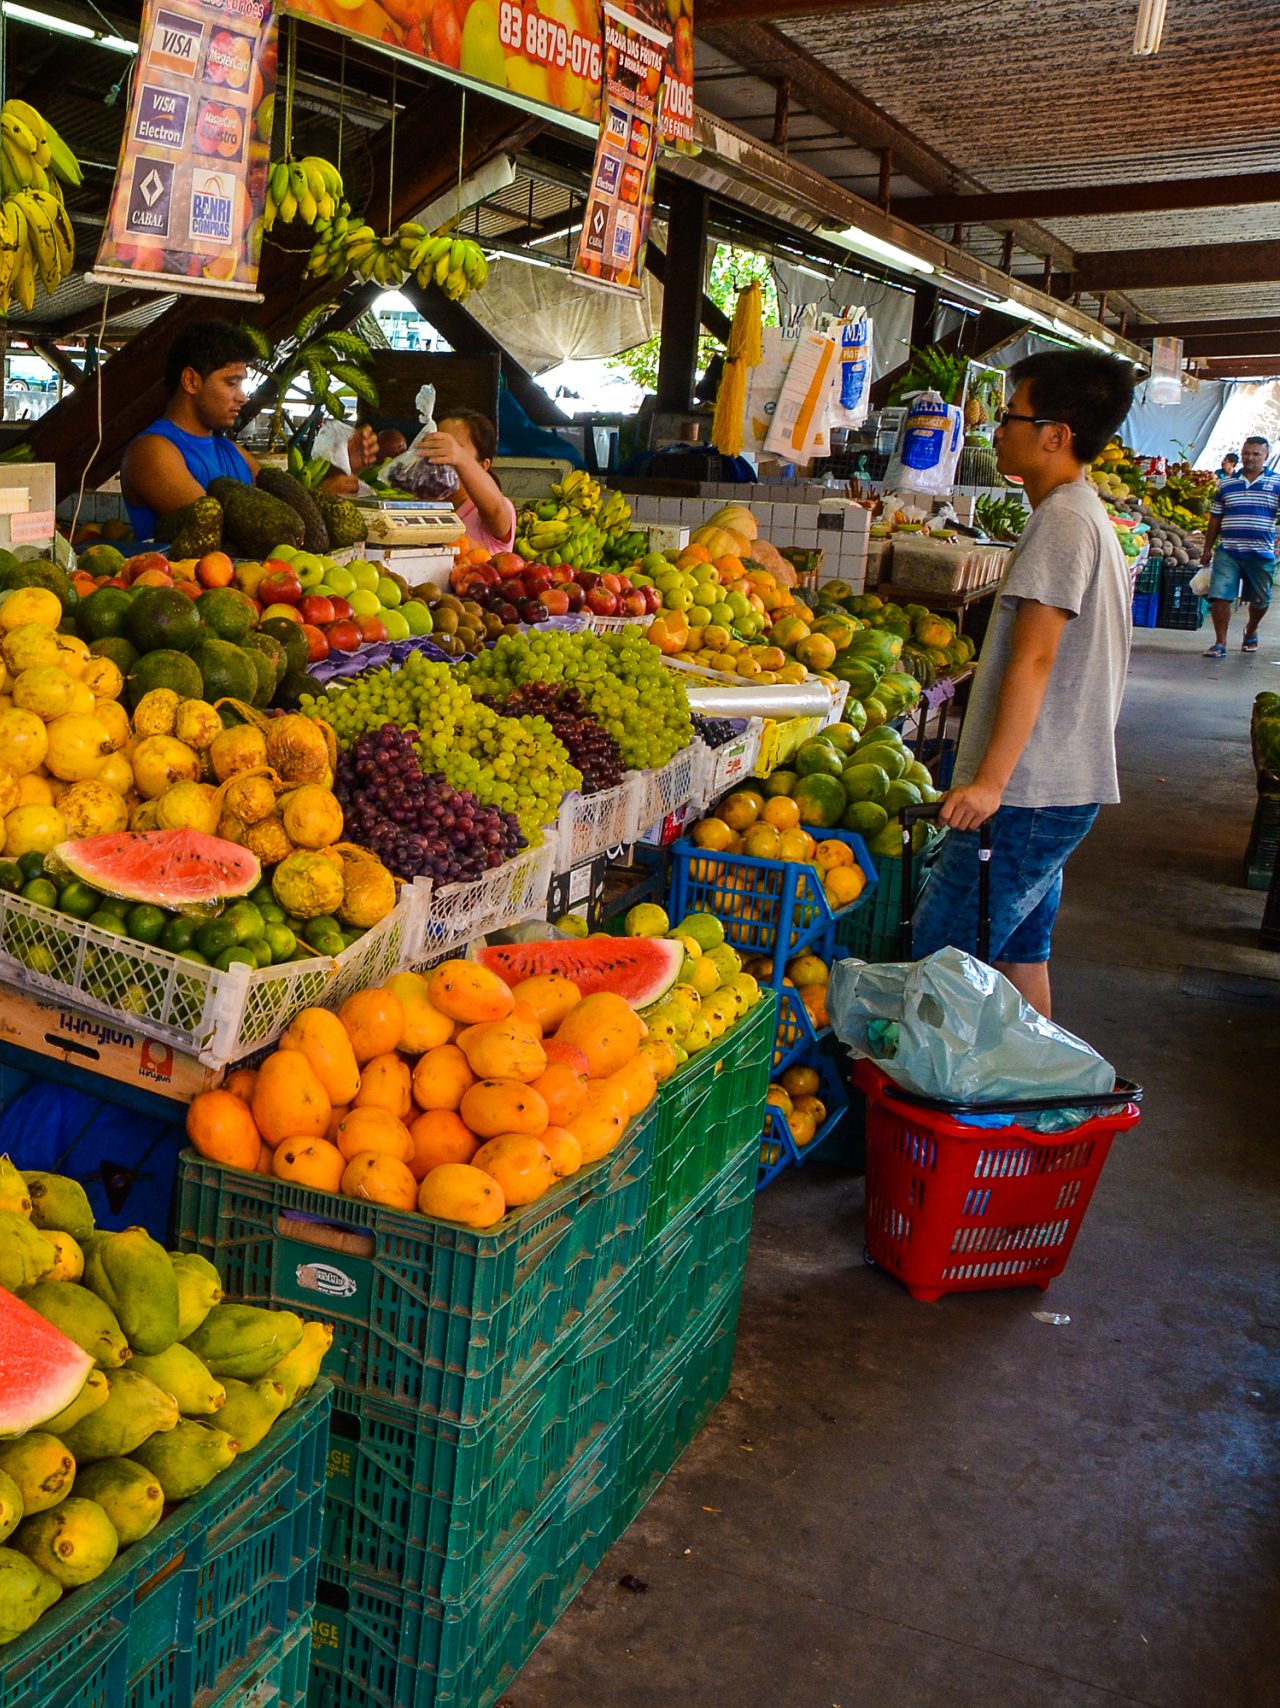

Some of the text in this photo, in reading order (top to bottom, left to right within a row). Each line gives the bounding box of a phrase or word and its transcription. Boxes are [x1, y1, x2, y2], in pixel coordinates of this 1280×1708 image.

[161, 30, 193, 58] VISA
[500, 2, 522, 48] 83
[526, 14, 603, 81] 8879-076
[605, 26, 662, 72] BAZAR DAS FRUTAS
[209, 49, 250, 71] MasterCard
[619, 54, 624, 66] 3
[152, 94, 176, 114] VISA
[204, 112, 237, 127] MasterCard
[612, 117, 625, 136] VISA
[138, 121, 180, 143] Electron
[193, 194, 231, 222] BANRI
[131, 210, 164, 228] CABAL
[192, 218, 230, 238] COMPRAS
[59, 1013, 135, 1049] unifrutti
[138, 1068, 172, 1083] unifrutti
